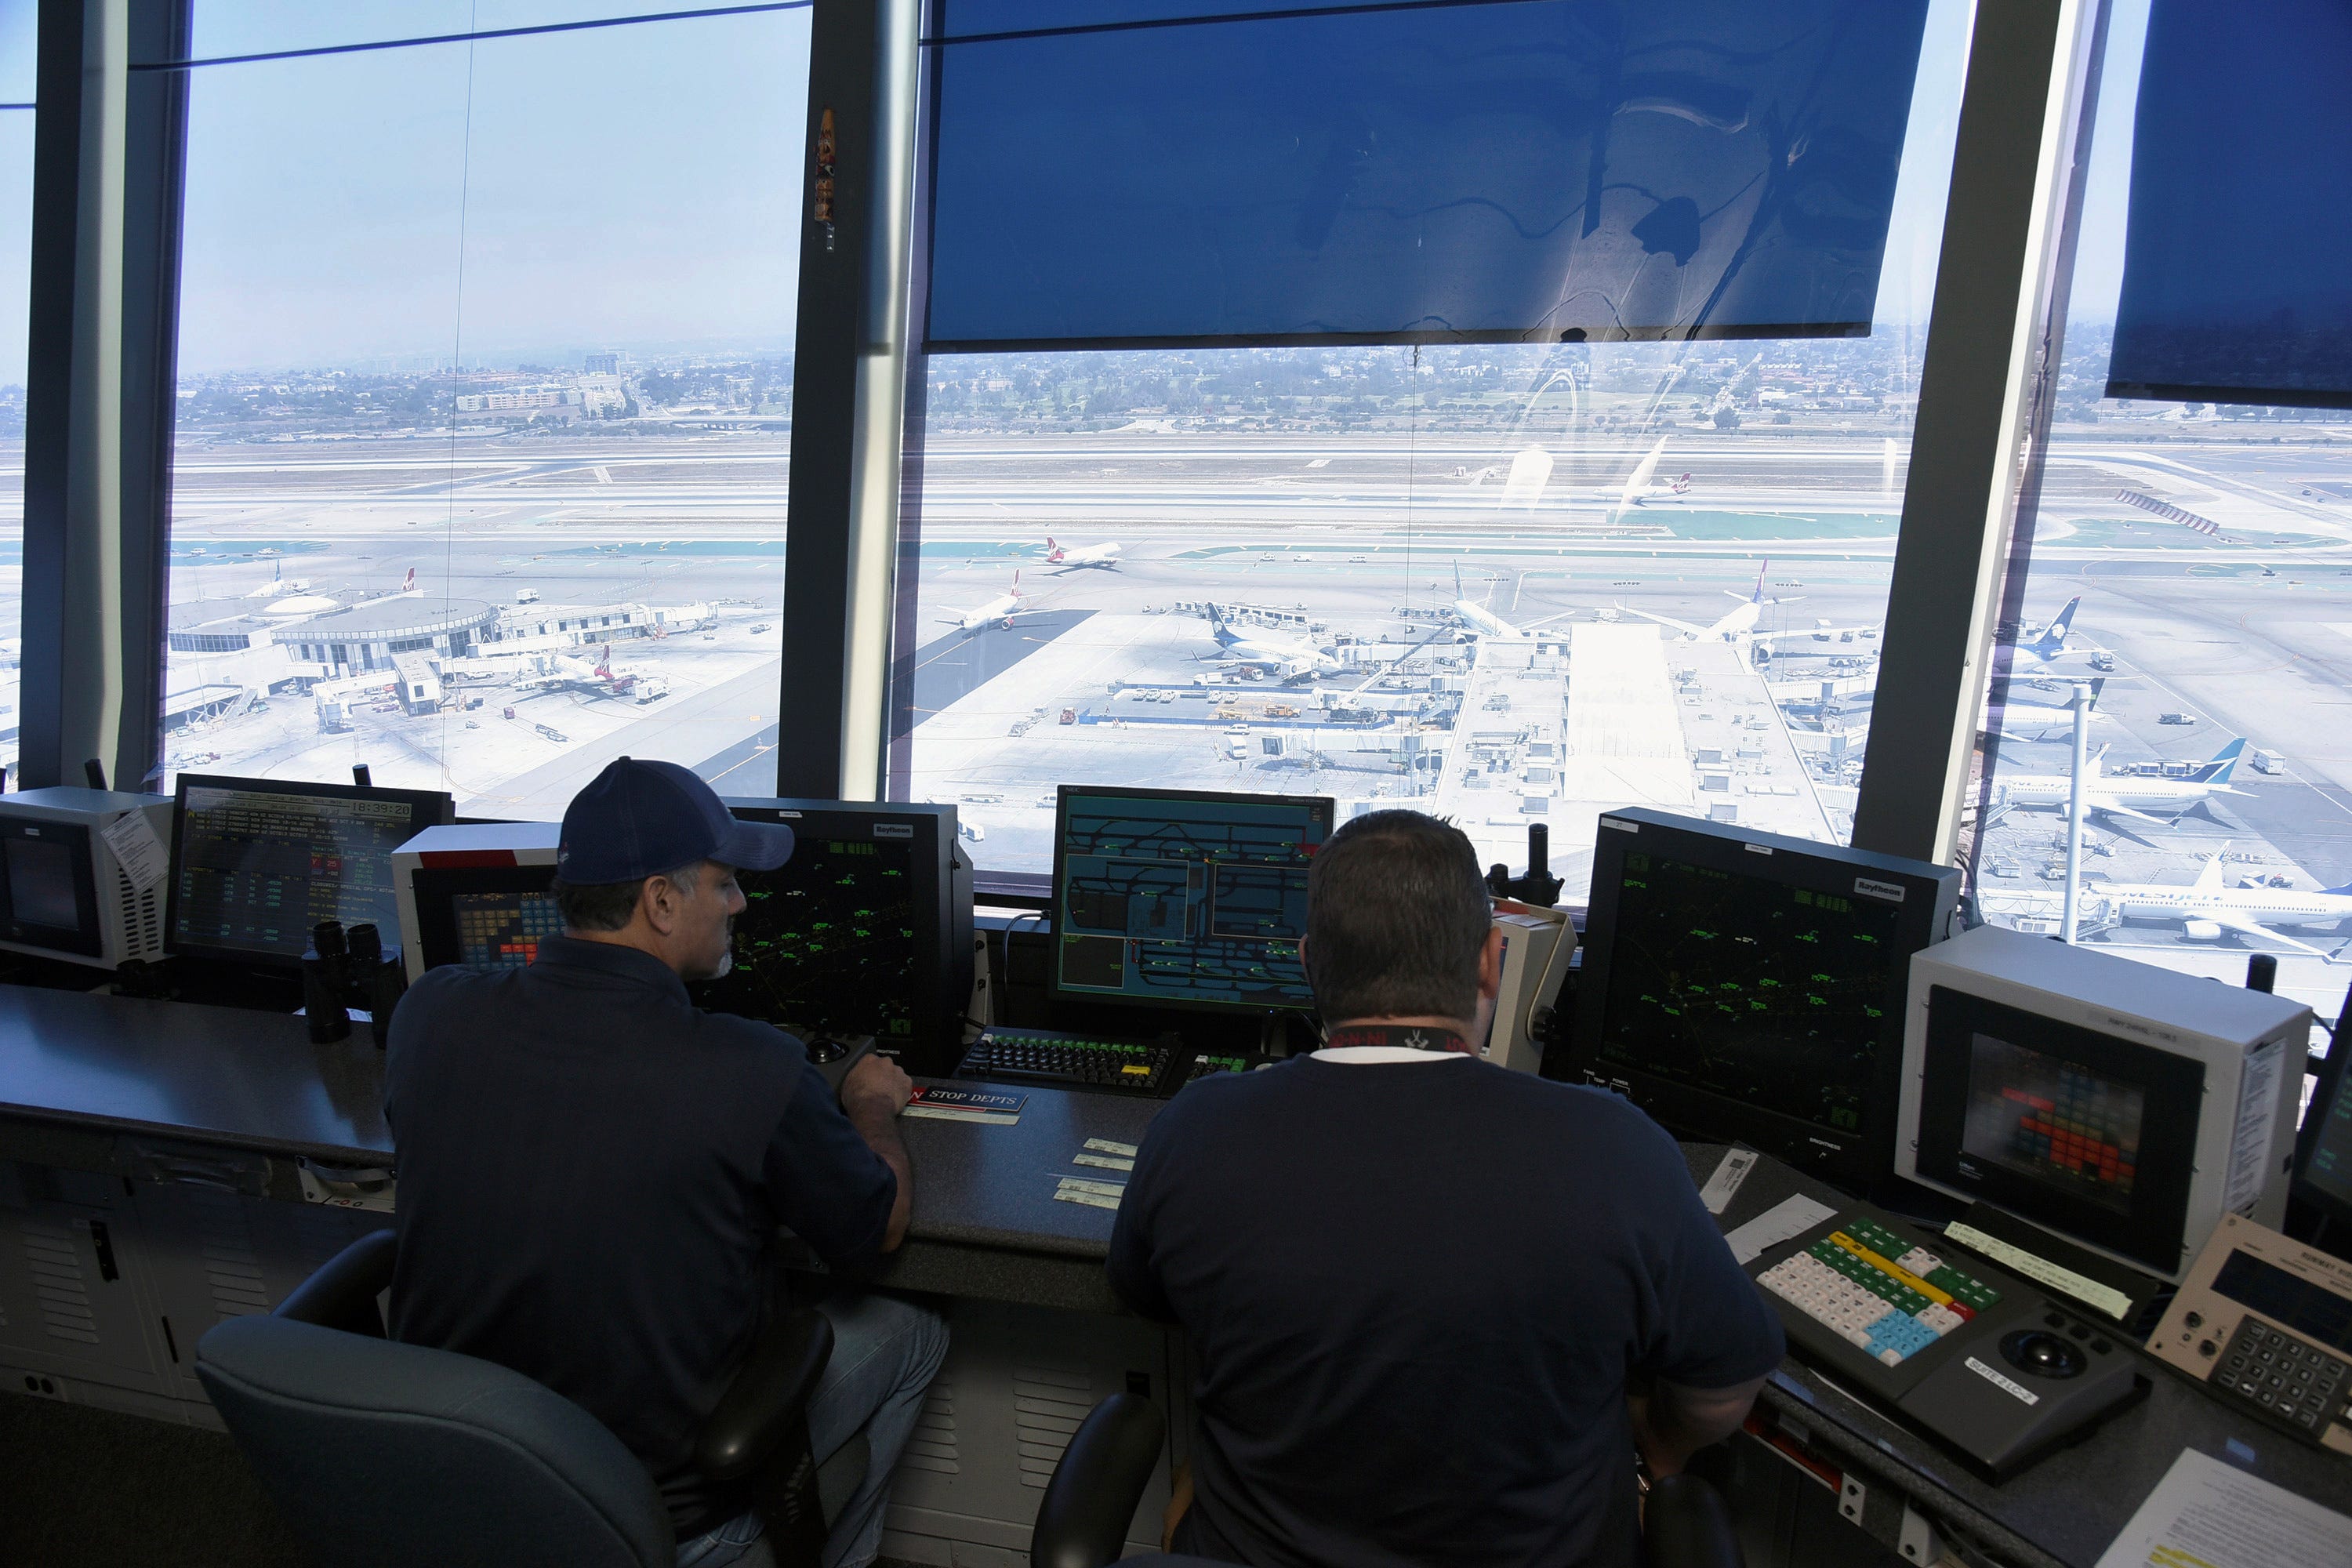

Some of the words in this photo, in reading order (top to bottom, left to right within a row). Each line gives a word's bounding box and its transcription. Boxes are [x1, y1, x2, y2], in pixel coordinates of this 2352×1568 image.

[352, 801, 410, 815] 18:39:20
[876, 826, 911, 836] Raytheon
[1858, 880, 1900, 896] Raytheon
[1611, 1077, 1629, 1087] POWER
[928, 1089, 967, 1101] STOP
[970, 1094, 1018, 1105] DEPTS
[1809, 1137, 1842, 1151] BRIGHTNESS
[1969, 1359, 1998, 1381] SUITE
